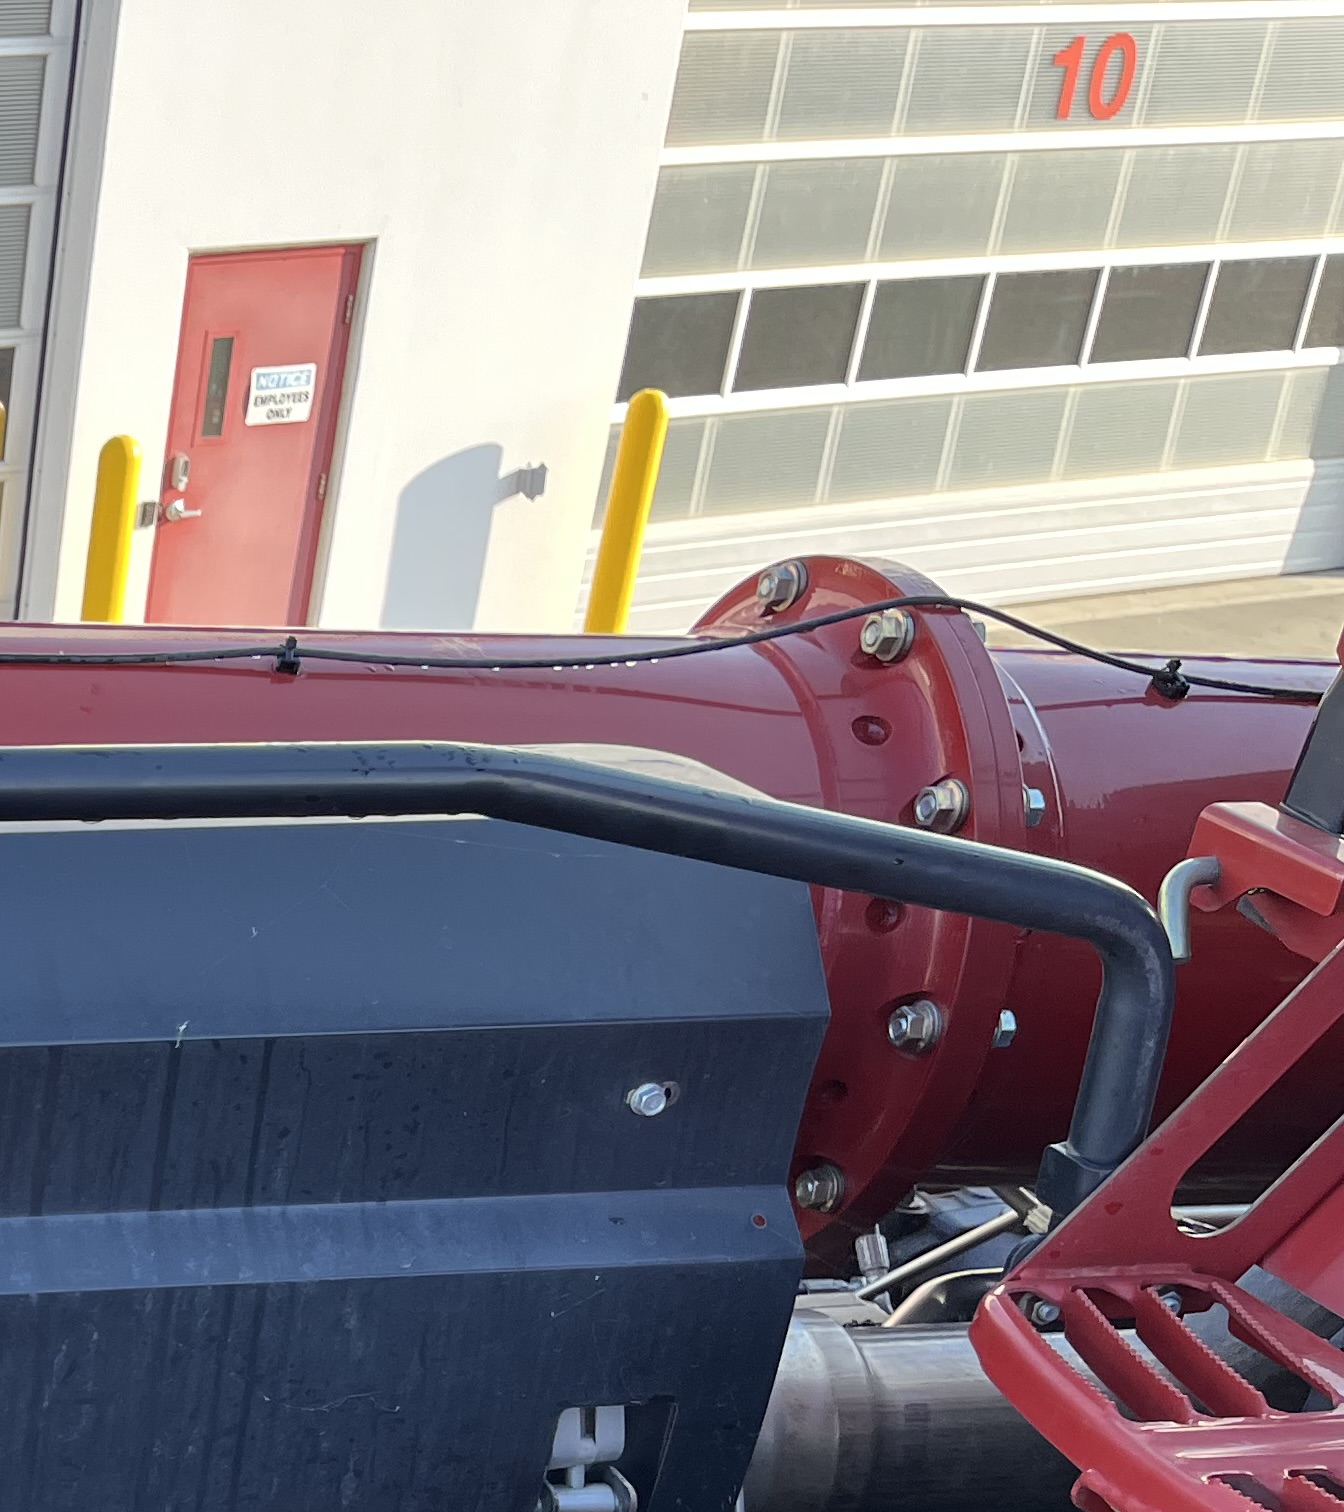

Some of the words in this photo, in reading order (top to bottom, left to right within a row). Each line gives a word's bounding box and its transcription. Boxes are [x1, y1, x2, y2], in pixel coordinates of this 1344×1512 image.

[1054, 32, 1137, 120] 10
[258, 371, 310, 387] NOTICE
[254, 391, 309, 407] EMPLOYEES
[266, 407, 292, 420] ONLY
